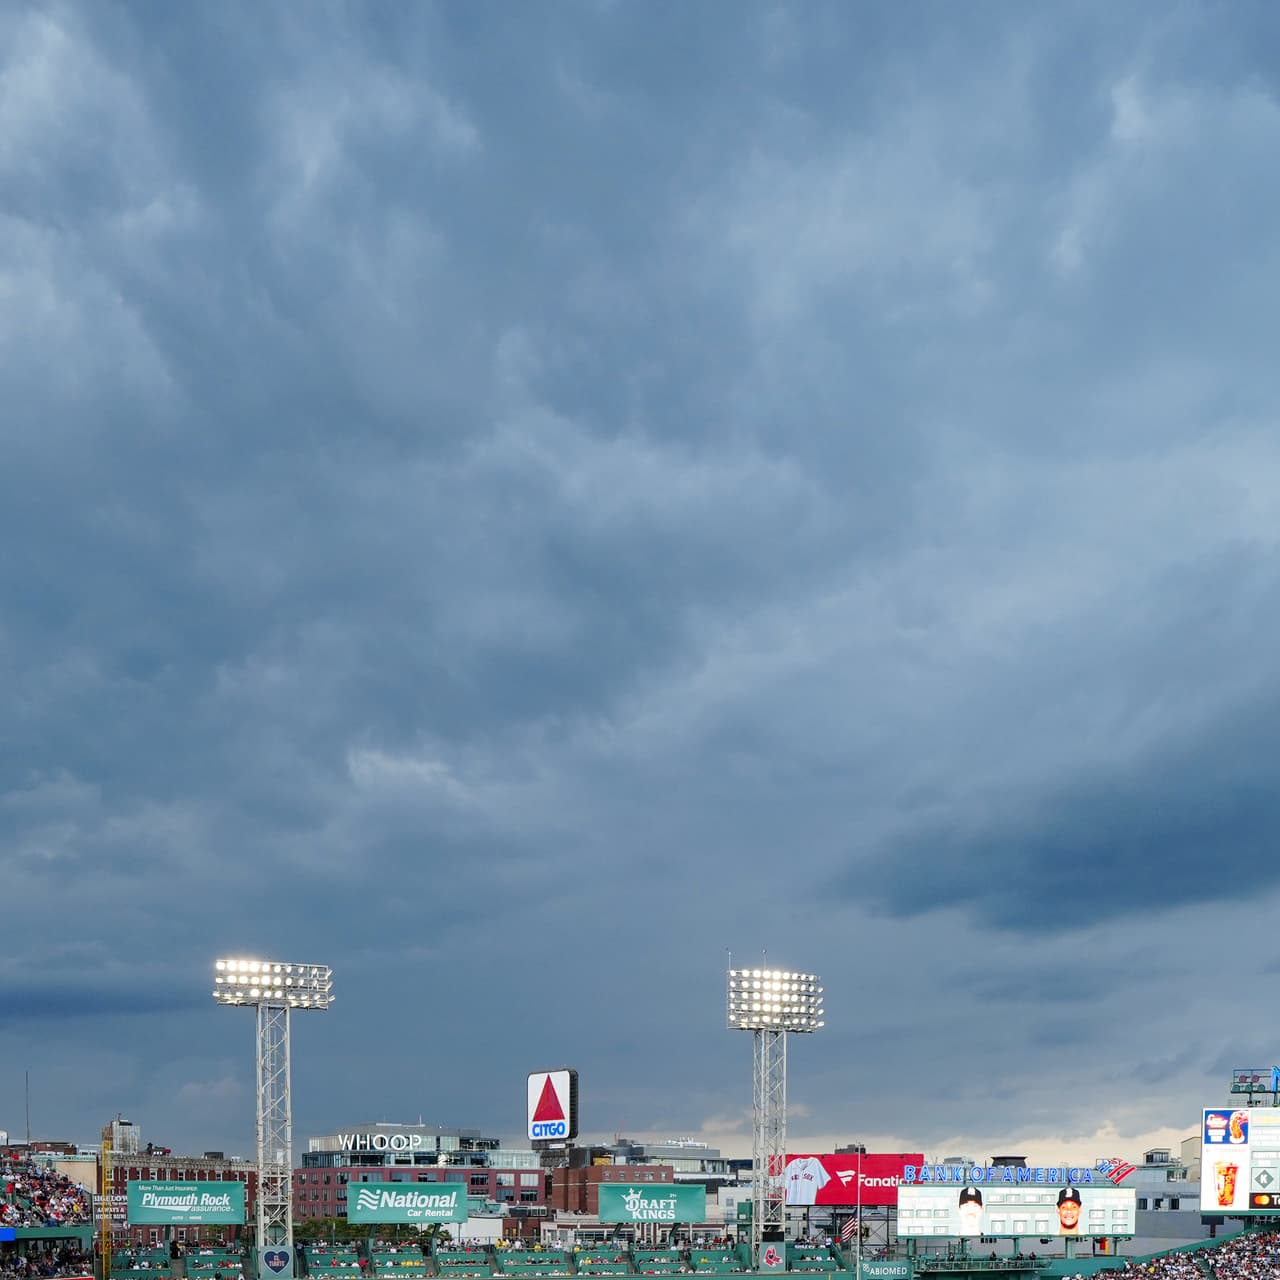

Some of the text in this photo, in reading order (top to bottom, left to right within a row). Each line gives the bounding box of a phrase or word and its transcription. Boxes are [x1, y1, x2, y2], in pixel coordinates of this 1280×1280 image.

[532, 1121, 565, 1137] CITGO
[338, 1134, 421, 1151] WHOOP
[904, 1166, 1093, 1184] BANK OF AMERICA
[1260, 1175, 1267, 1183] K
[141, 1193, 230, 1207] Plymouth Rock
[380, 1191, 457, 1207] National
[625, 1199, 677, 1211] DRAFT
[632, 1210, 675, 1219] KINGS
[870, 1267, 907, 1275] ABIOMED
